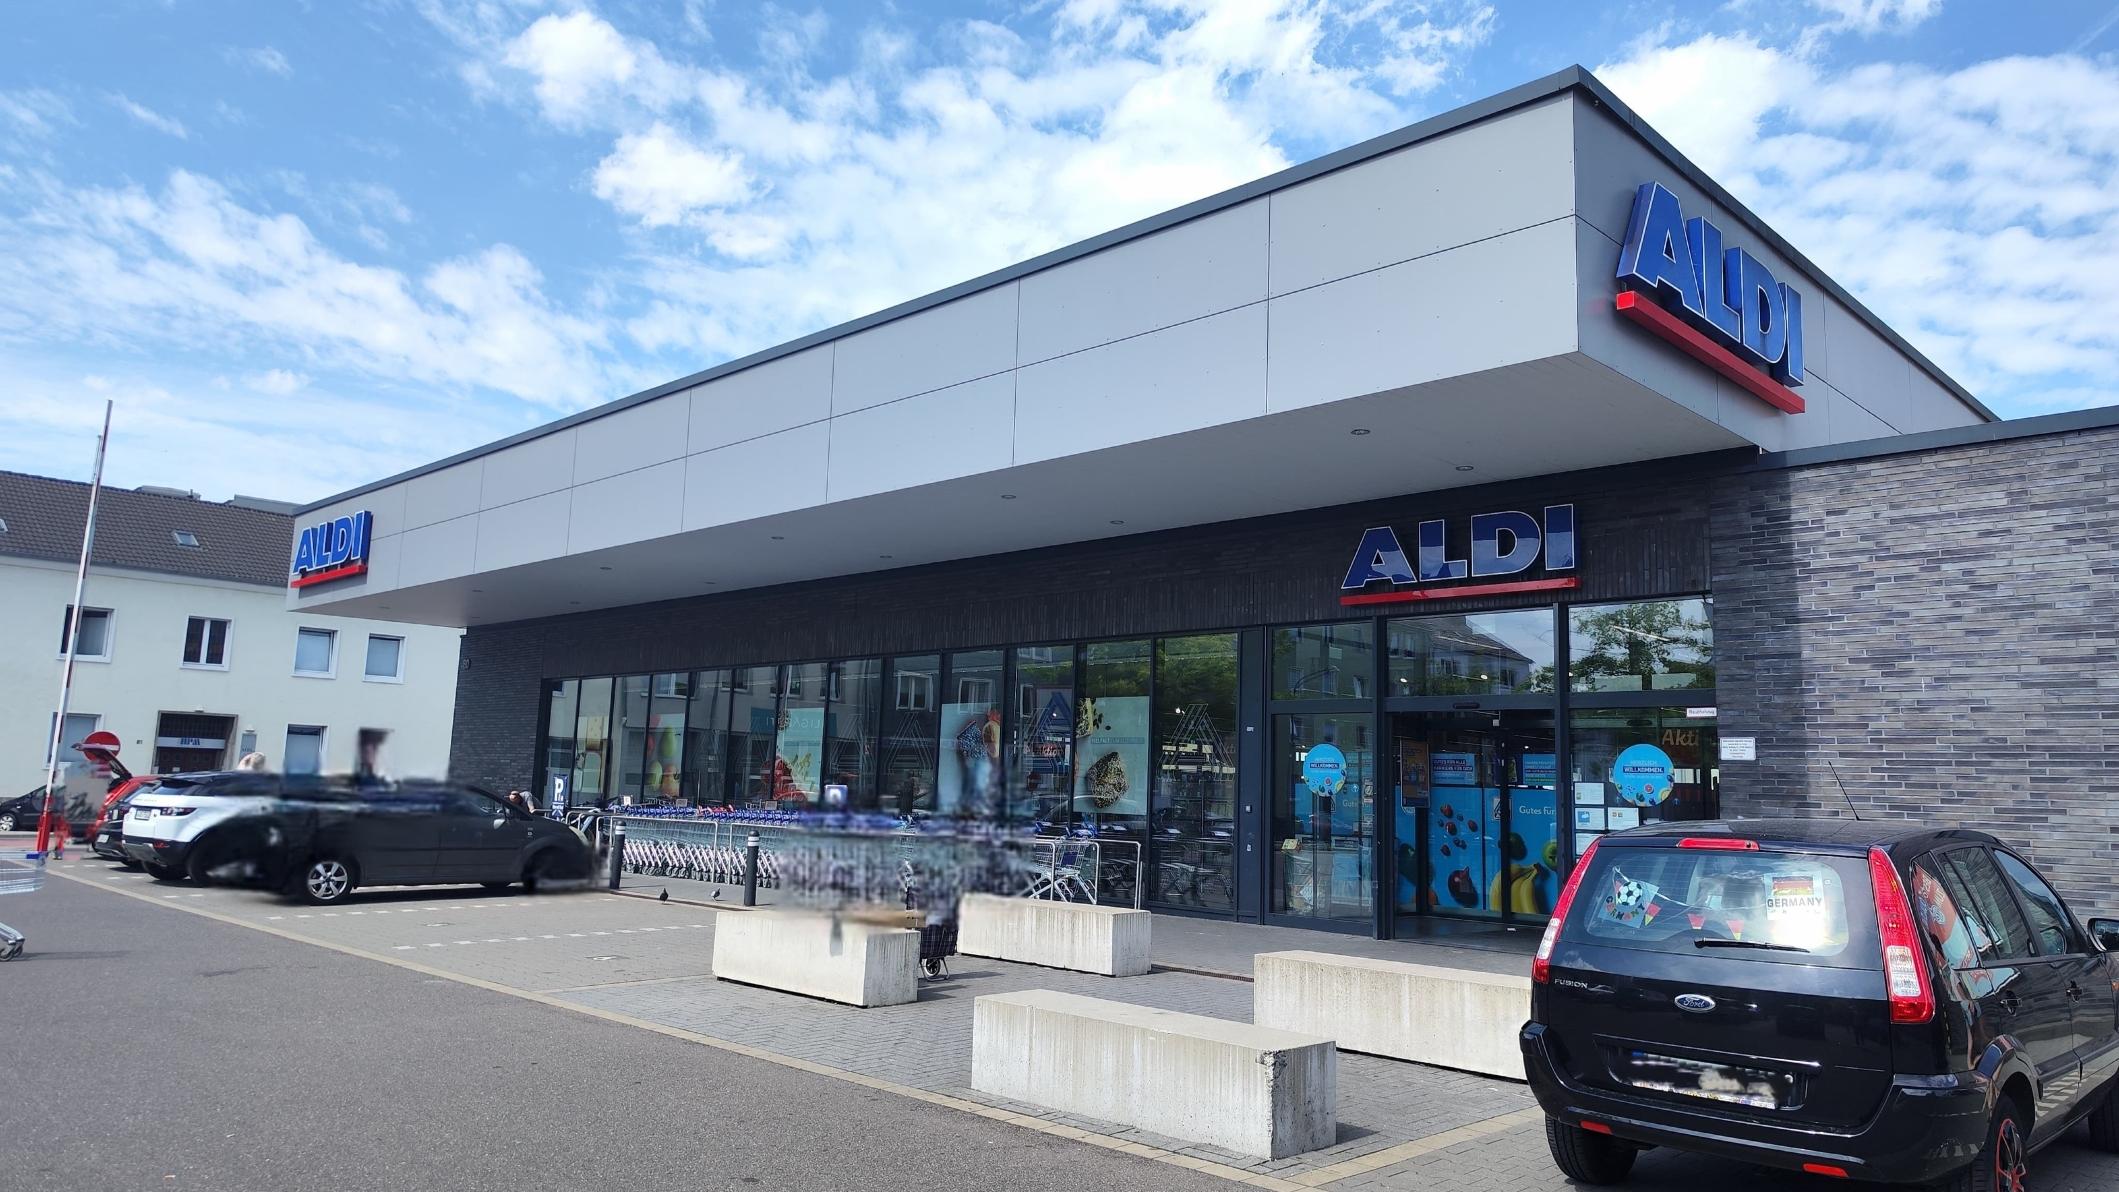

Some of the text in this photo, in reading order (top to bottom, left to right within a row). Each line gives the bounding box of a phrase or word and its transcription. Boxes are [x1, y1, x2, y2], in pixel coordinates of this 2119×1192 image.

[1617, 181, 1804, 387] ALDI
[291, 510, 371, 576] ALDI
[1340, 503, 1576, 590] ALDI
[1519, 805, 1541, 815] Gutes
[1605, 895, 1645, 921] GERMANY
[1767, 897, 1822, 908] GERMANY
[1554, 978, 1589, 989] FUSION
[1683, 996, 1706, 1008] Ford
